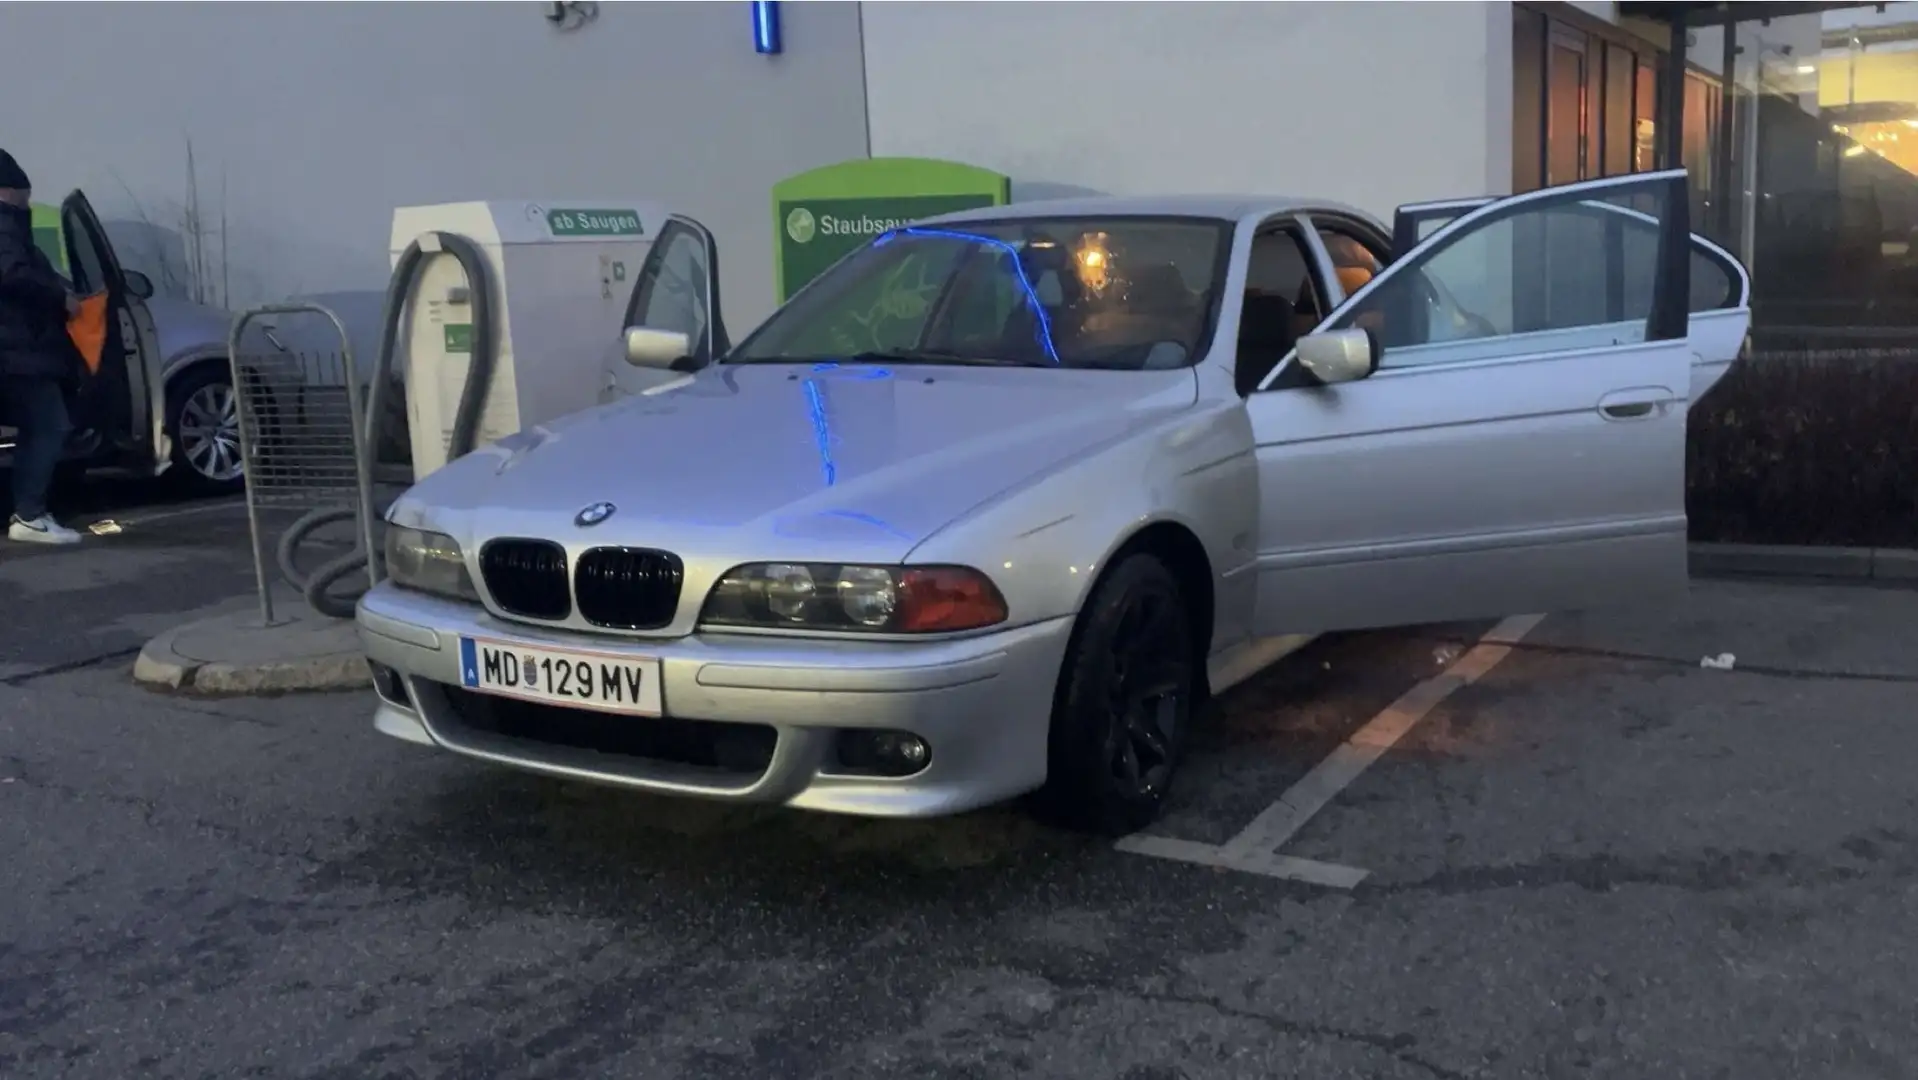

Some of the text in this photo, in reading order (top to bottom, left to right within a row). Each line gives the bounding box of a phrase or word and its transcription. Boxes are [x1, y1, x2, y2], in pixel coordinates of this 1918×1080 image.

[578, 212, 638, 233] Saugen
[467, 667, 476, 680] A
[483, 647, 642, 705] MD 129 MV
